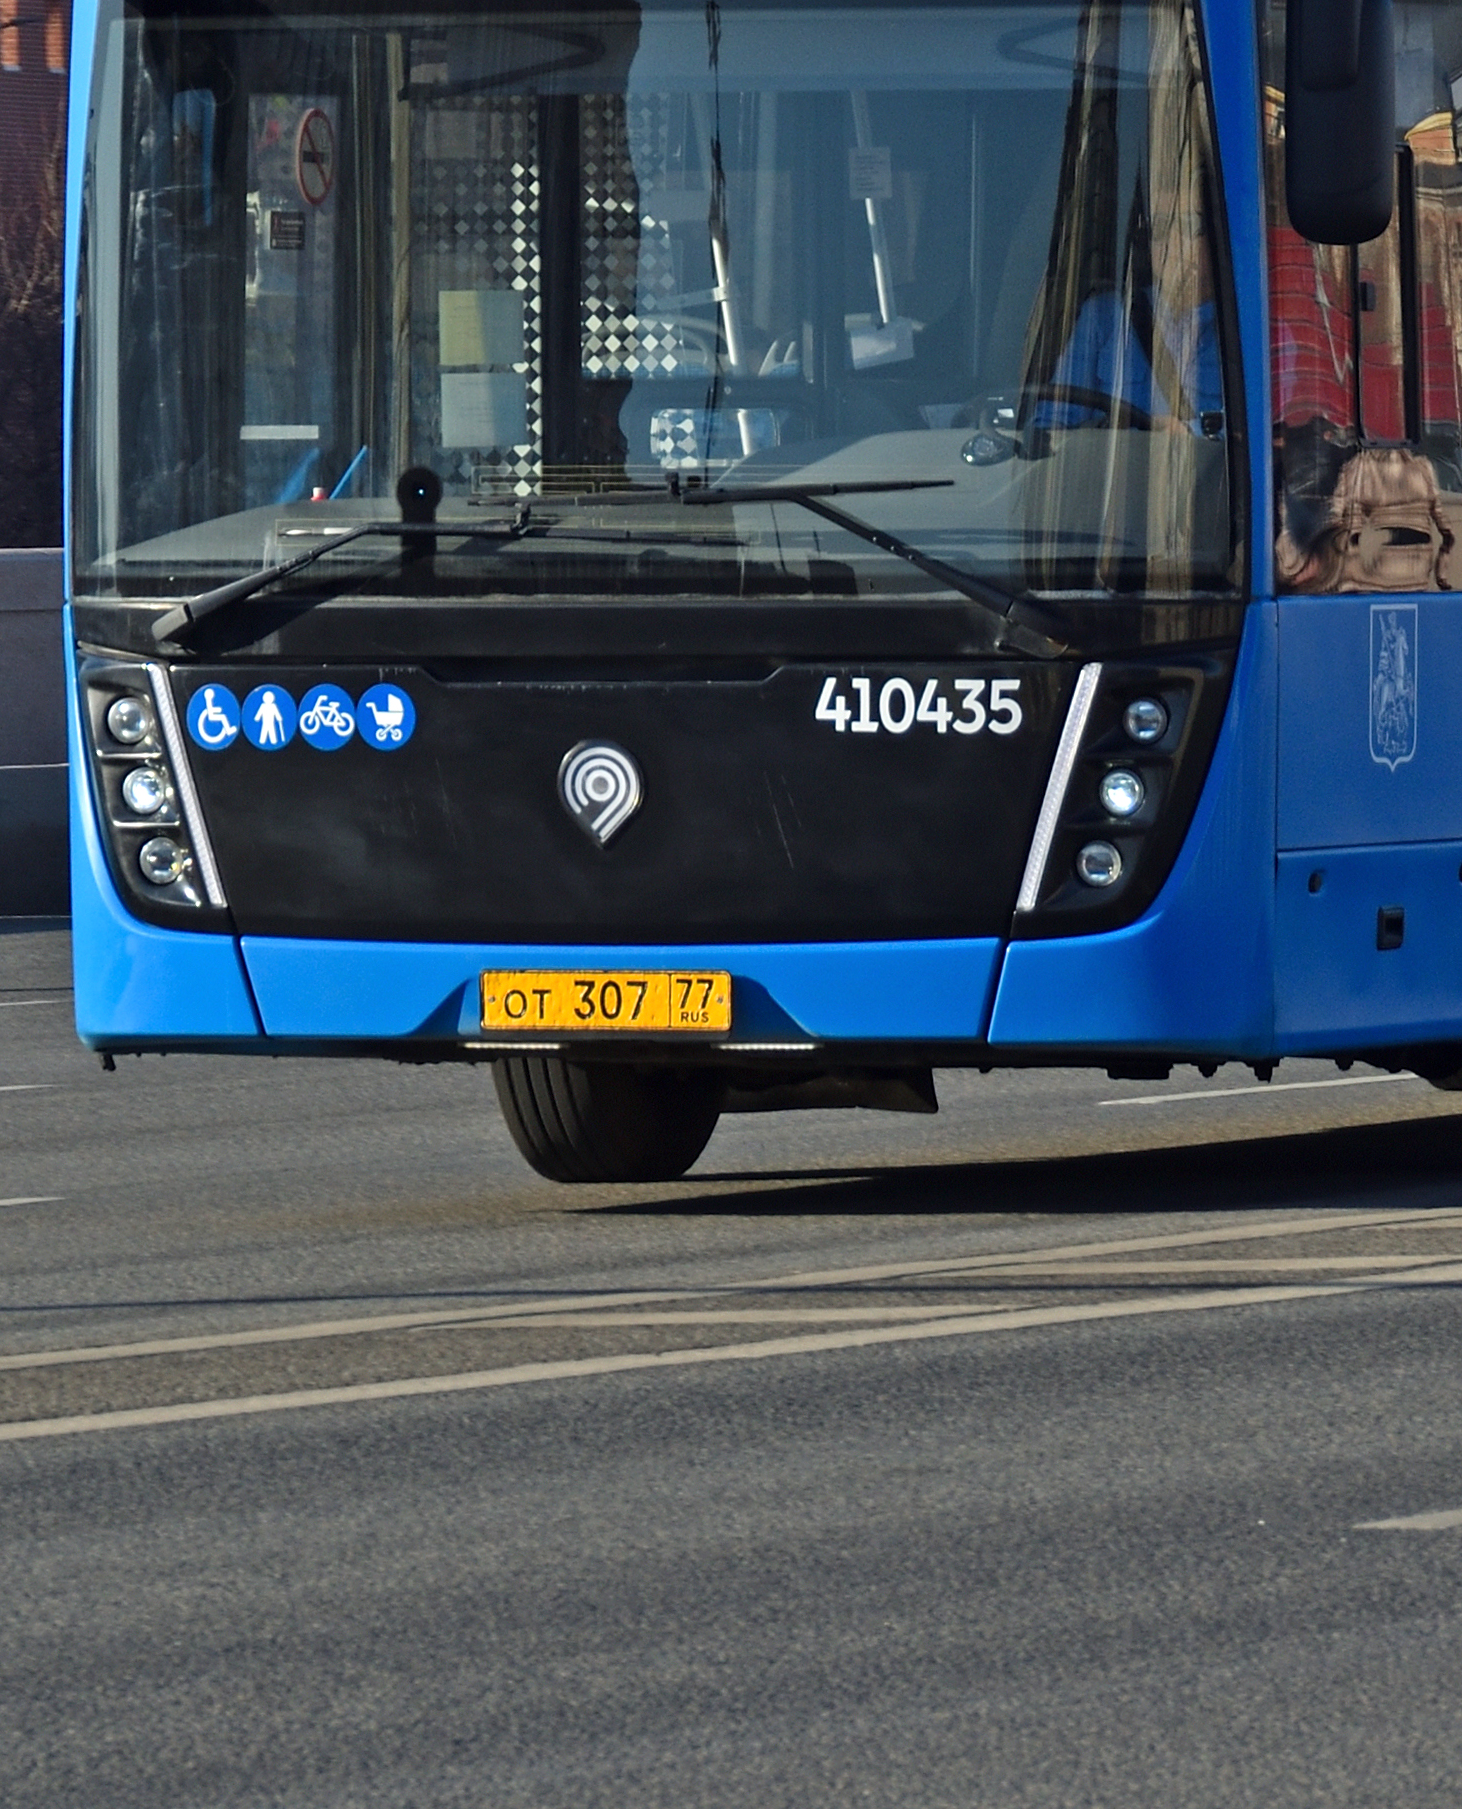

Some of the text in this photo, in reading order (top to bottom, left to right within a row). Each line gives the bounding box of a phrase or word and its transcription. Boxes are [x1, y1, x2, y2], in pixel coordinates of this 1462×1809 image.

[815, 677, 1023, 734] 410435
[574, 979, 649, 1021] 307
[676, 979, 714, 1009] 77
[680, 1011, 710, 1024] RUS
